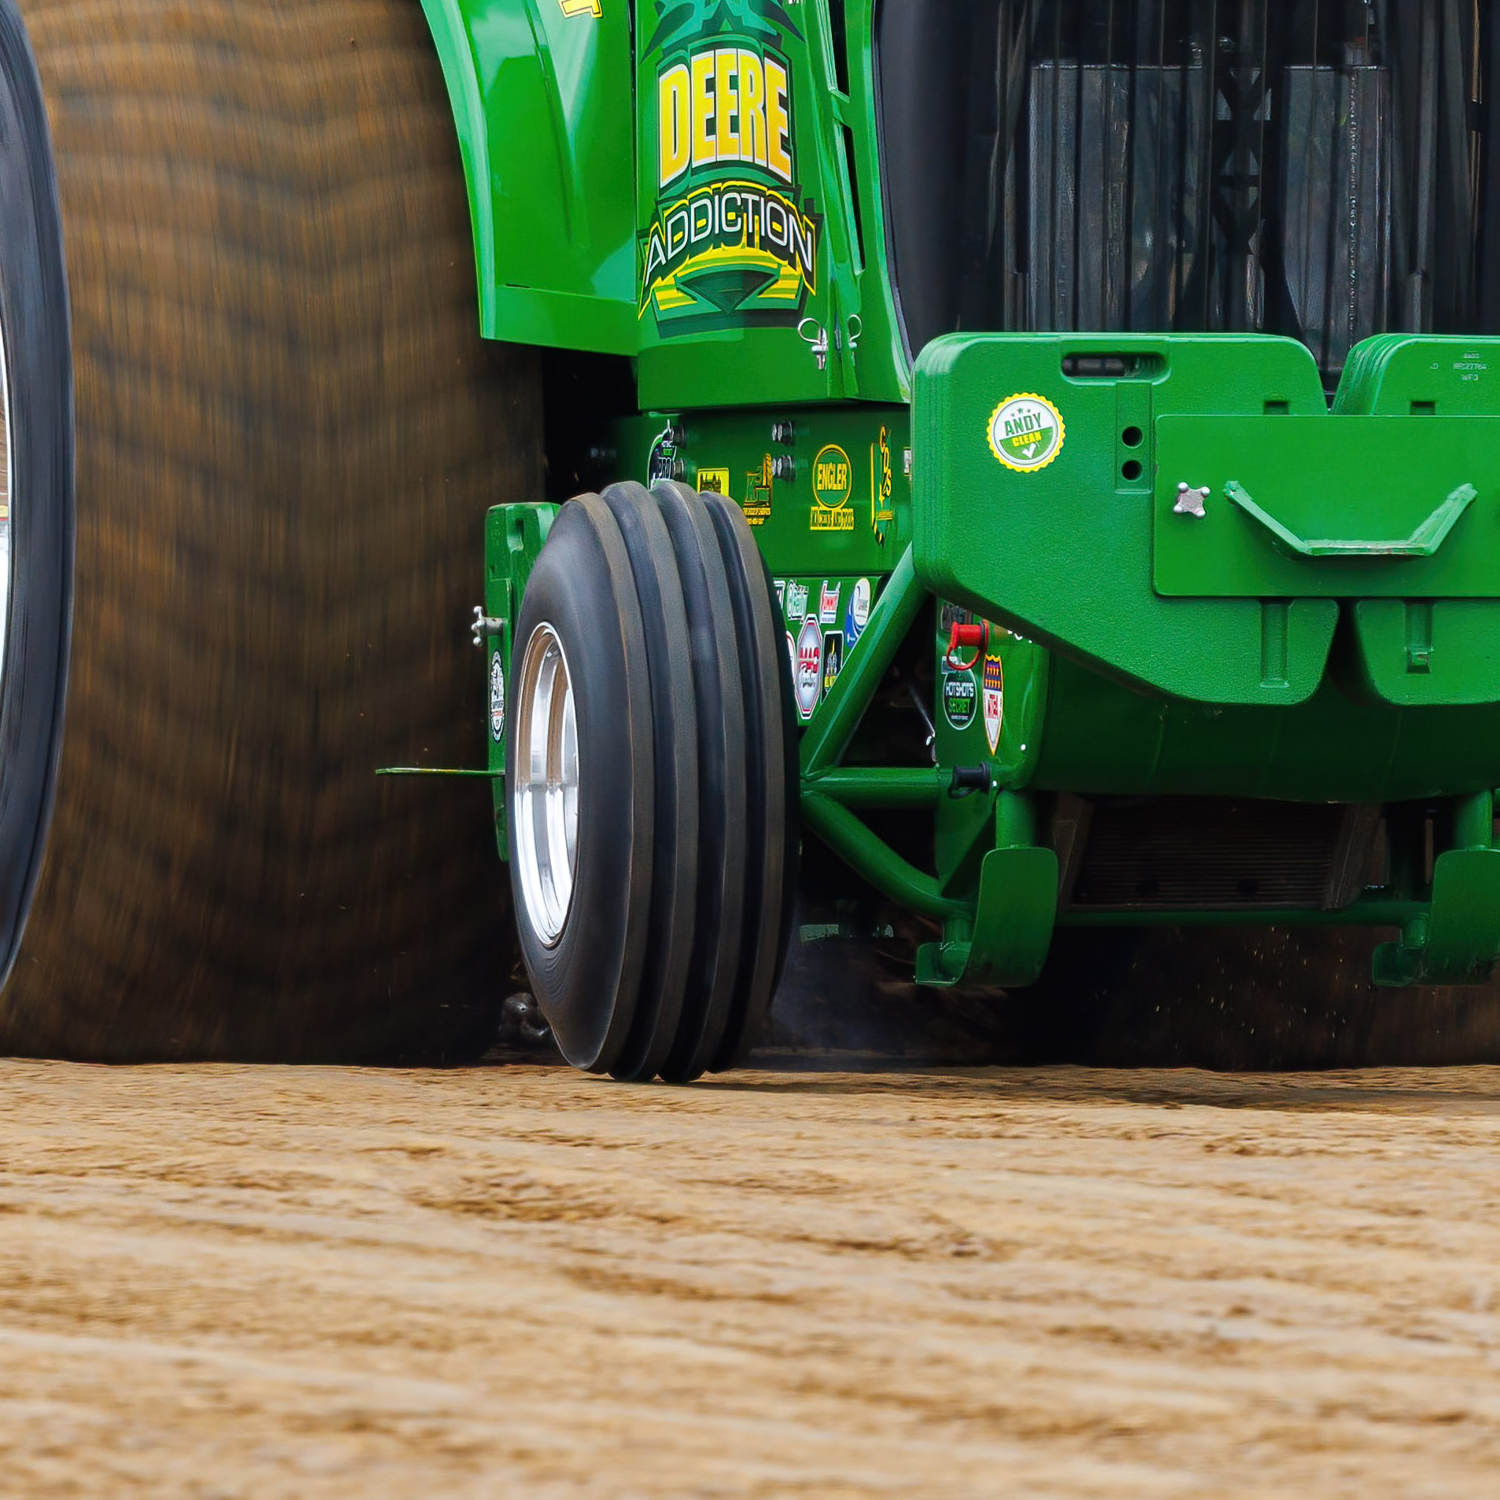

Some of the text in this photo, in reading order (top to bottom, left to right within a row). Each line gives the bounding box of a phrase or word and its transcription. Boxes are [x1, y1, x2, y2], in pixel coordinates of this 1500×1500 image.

[659, 48, 792, 189] DEERE
[644, 192, 813, 288] ADDICTION
[1004, 412, 1041, 437] ANDY
[1012, 431, 1043, 447] CLEAN
[817, 463, 848, 491] ENGLER
